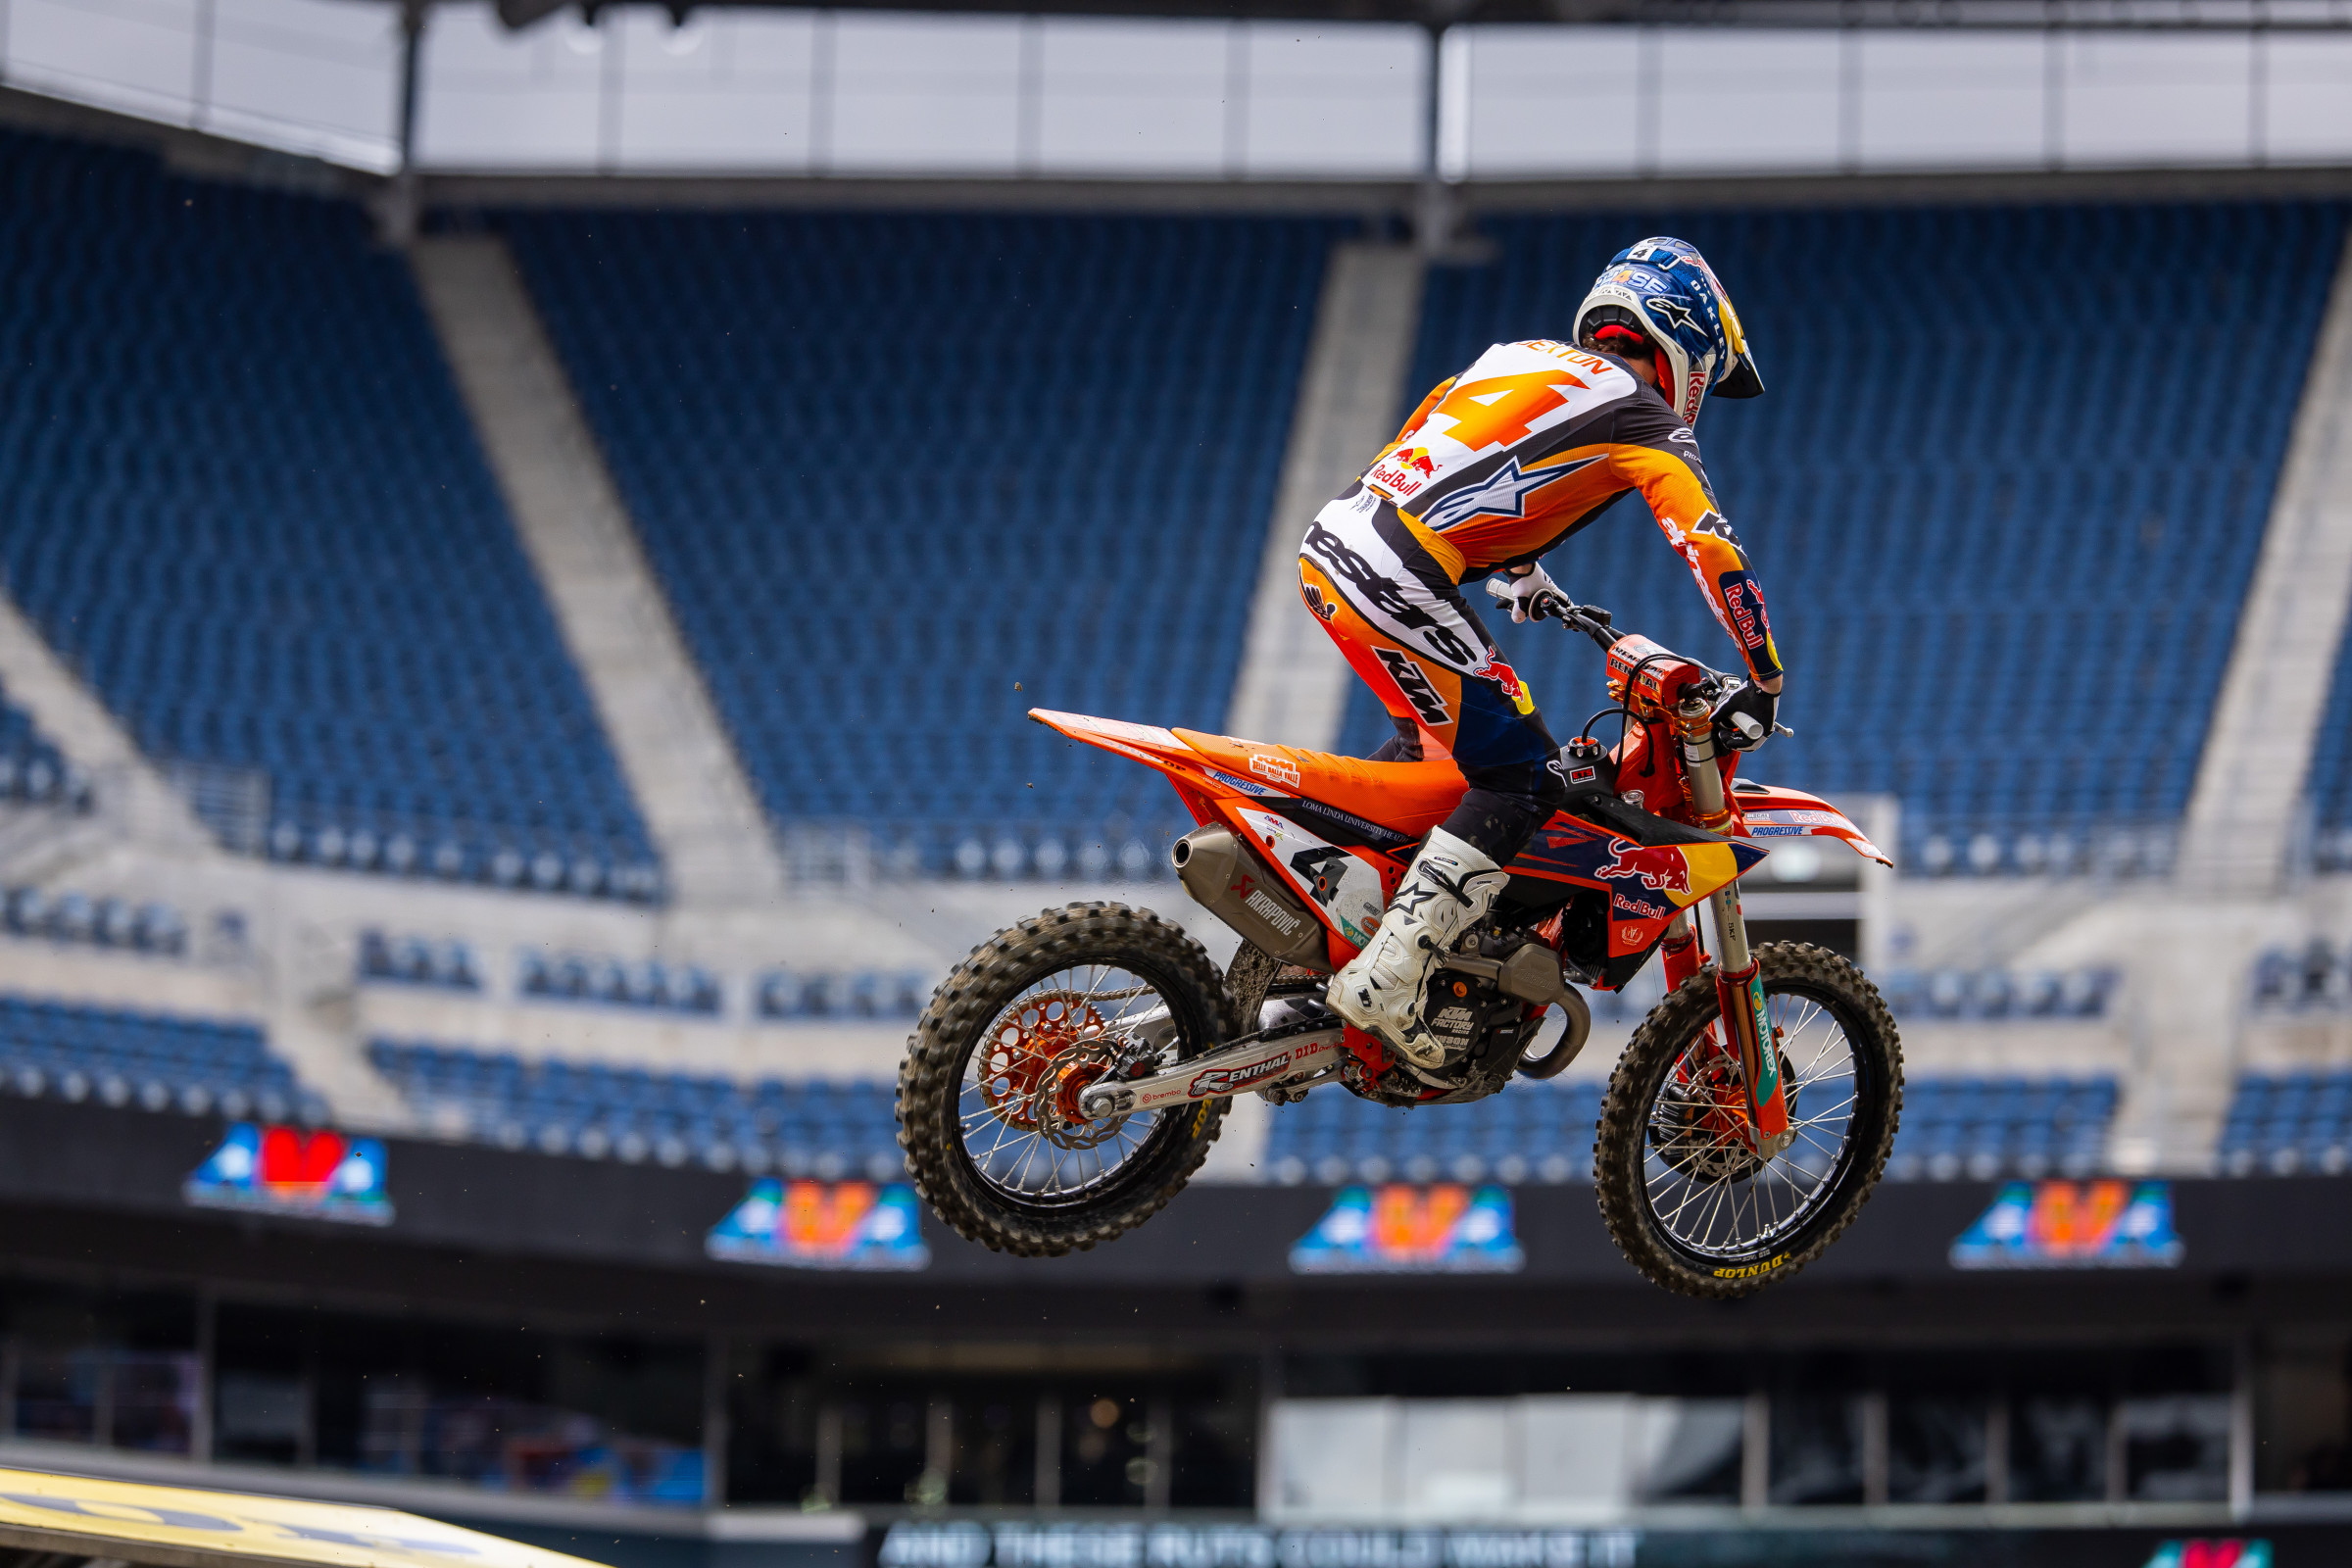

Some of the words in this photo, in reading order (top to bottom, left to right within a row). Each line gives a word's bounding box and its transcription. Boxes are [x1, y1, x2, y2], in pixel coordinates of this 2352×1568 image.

[1632, 248, 1648, 259] 4
[1690, 279, 1726, 360] OAKLEY
[1430, 368, 1592, 453] 4
[1370, 645, 1453, 726] KTM
[1609, 657, 1660, 692] RENHAL
[1213, 771, 1268, 796] PROGRESSIVE
[1572, 768, 1592, 779] ETS
[1301, 800, 1322, 813] LOMA
[1322, 807, 1344, 821] LINDA
[1345, 813, 1385, 836] UNIVERSITY
[1751, 826, 1804, 837] PROGRESSIVE
[1290, 845, 1353, 908] 4
[1245, 889, 1301, 936] AKRAPOVIČ
[1431, 1017, 1475, 1031] FACTORY
[1437, 1005, 1473, 1022] KTM
[1295, 1042, 1318, 1059] DID
[1756, 1008, 1777, 1078] MOTOREX
[1152, 1088, 1182, 1102] brembo
[1713, 1254, 1784, 1279] DUNLOP
